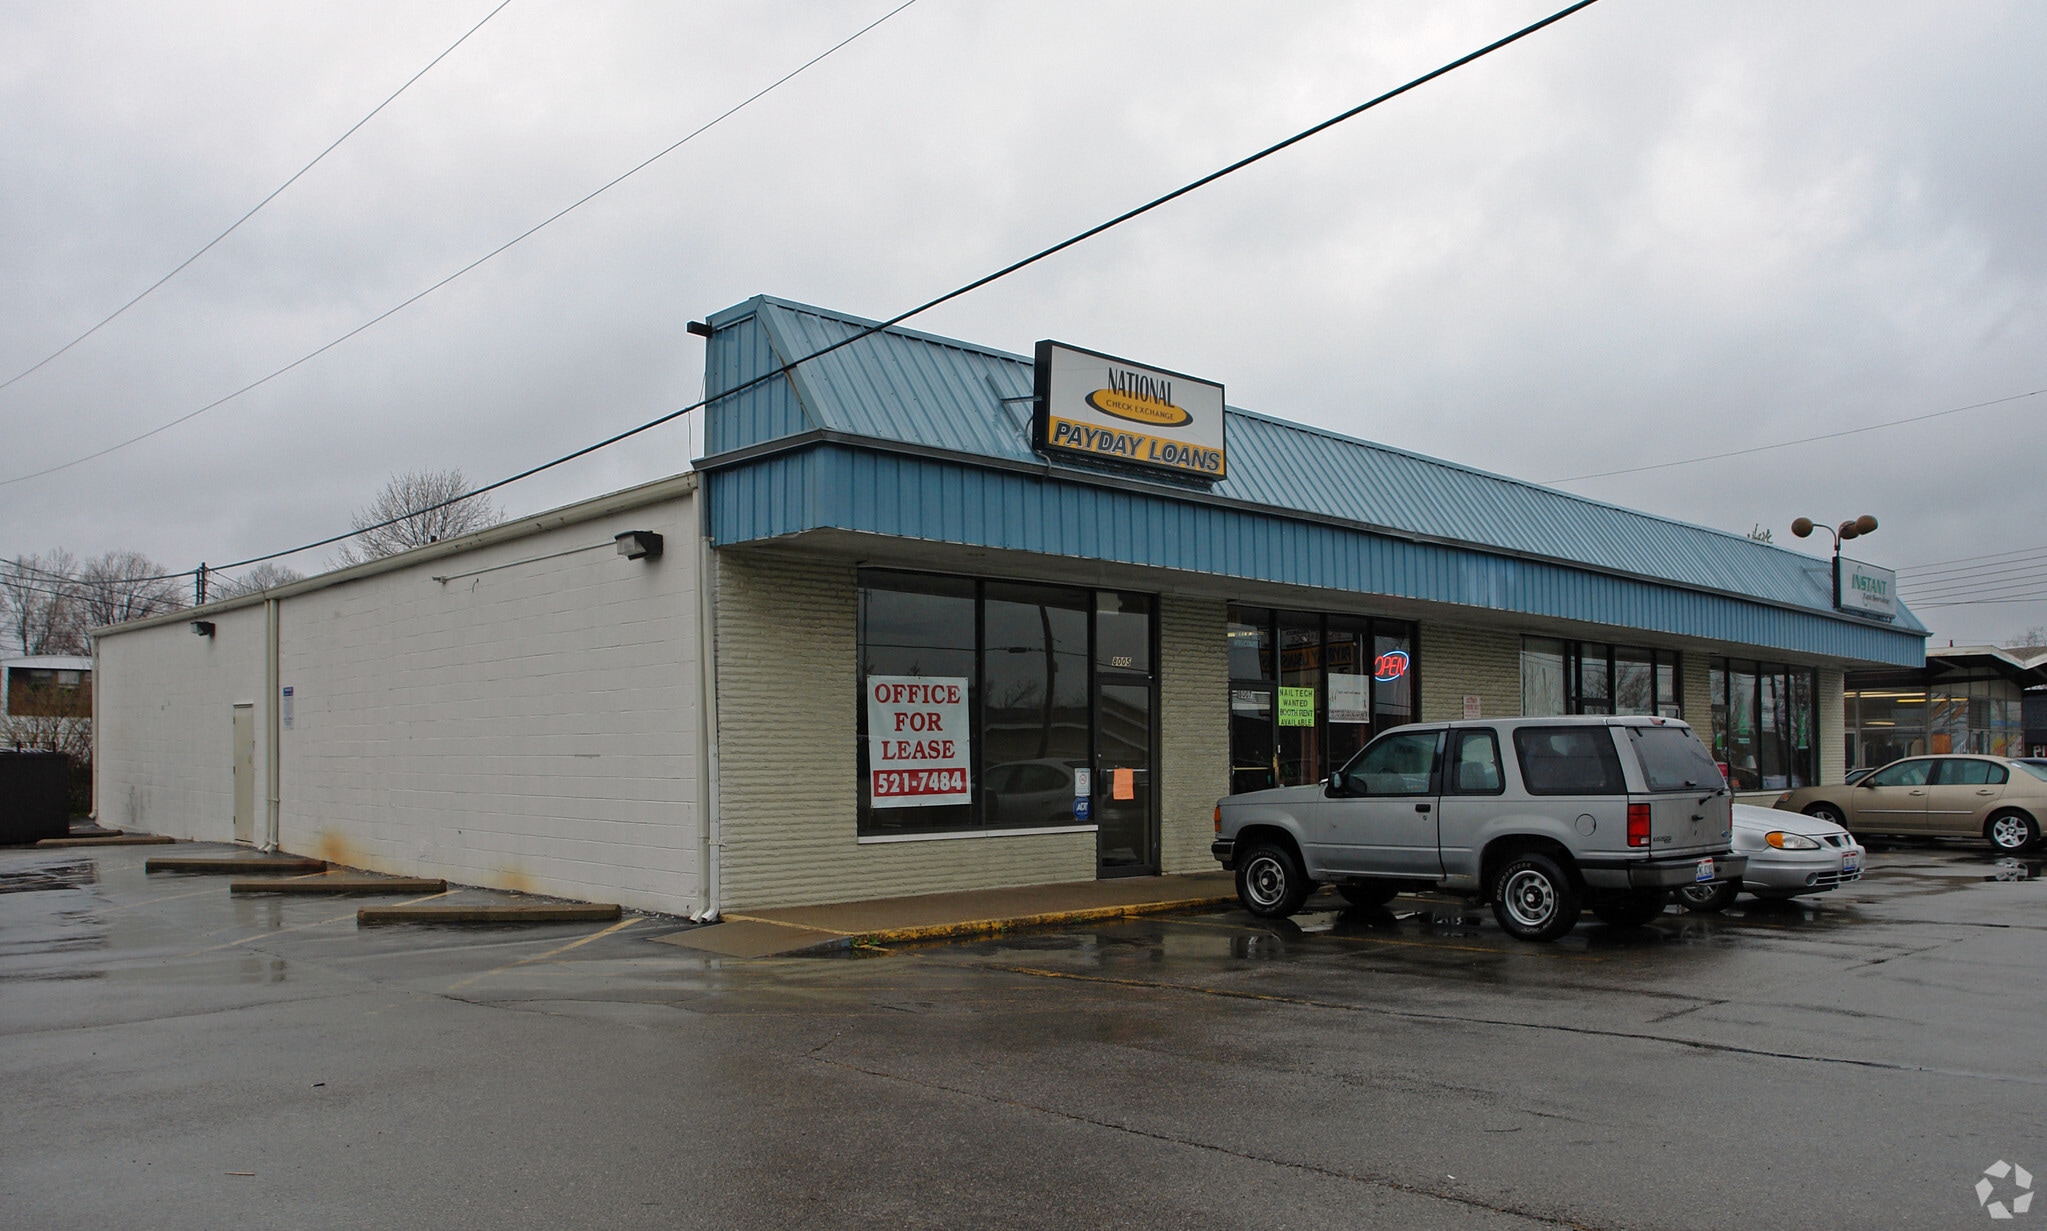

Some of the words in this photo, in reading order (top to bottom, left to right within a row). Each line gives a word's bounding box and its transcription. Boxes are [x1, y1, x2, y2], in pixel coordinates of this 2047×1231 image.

[1107, 367, 1175, 408] NATIONAL
[1106, 399, 1133, 412] CHECK
[1134, 405, 1175, 421] EXCHANGE
[1052, 421, 1145, 457] PAYDAY
[1148, 440, 1222, 473] LOANS
[1851, 573, 1888, 595] INSTANT
[1113, 657, 1131, 666] 8005
[1374, 655, 1407, 676] OPEN
[874, 683, 961, 704] OFFICE
[1280, 688, 1294, 697] NAIL
[1295, 689, 1313, 698] TECH
[1283, 698, 1308, 707] WANTED
[894, 712, 943, 732] FOR
[1279, 708, 1298, 717] BOOTH
[1299, 709, 1313, 717] RENT
[1281, 718, 1312, 726] AVAILABLE
[881, 740, 956, 760] LEASE
[878, 771, 962, 794] 521-7484
[1076, 802, 1089, 812] ADT
